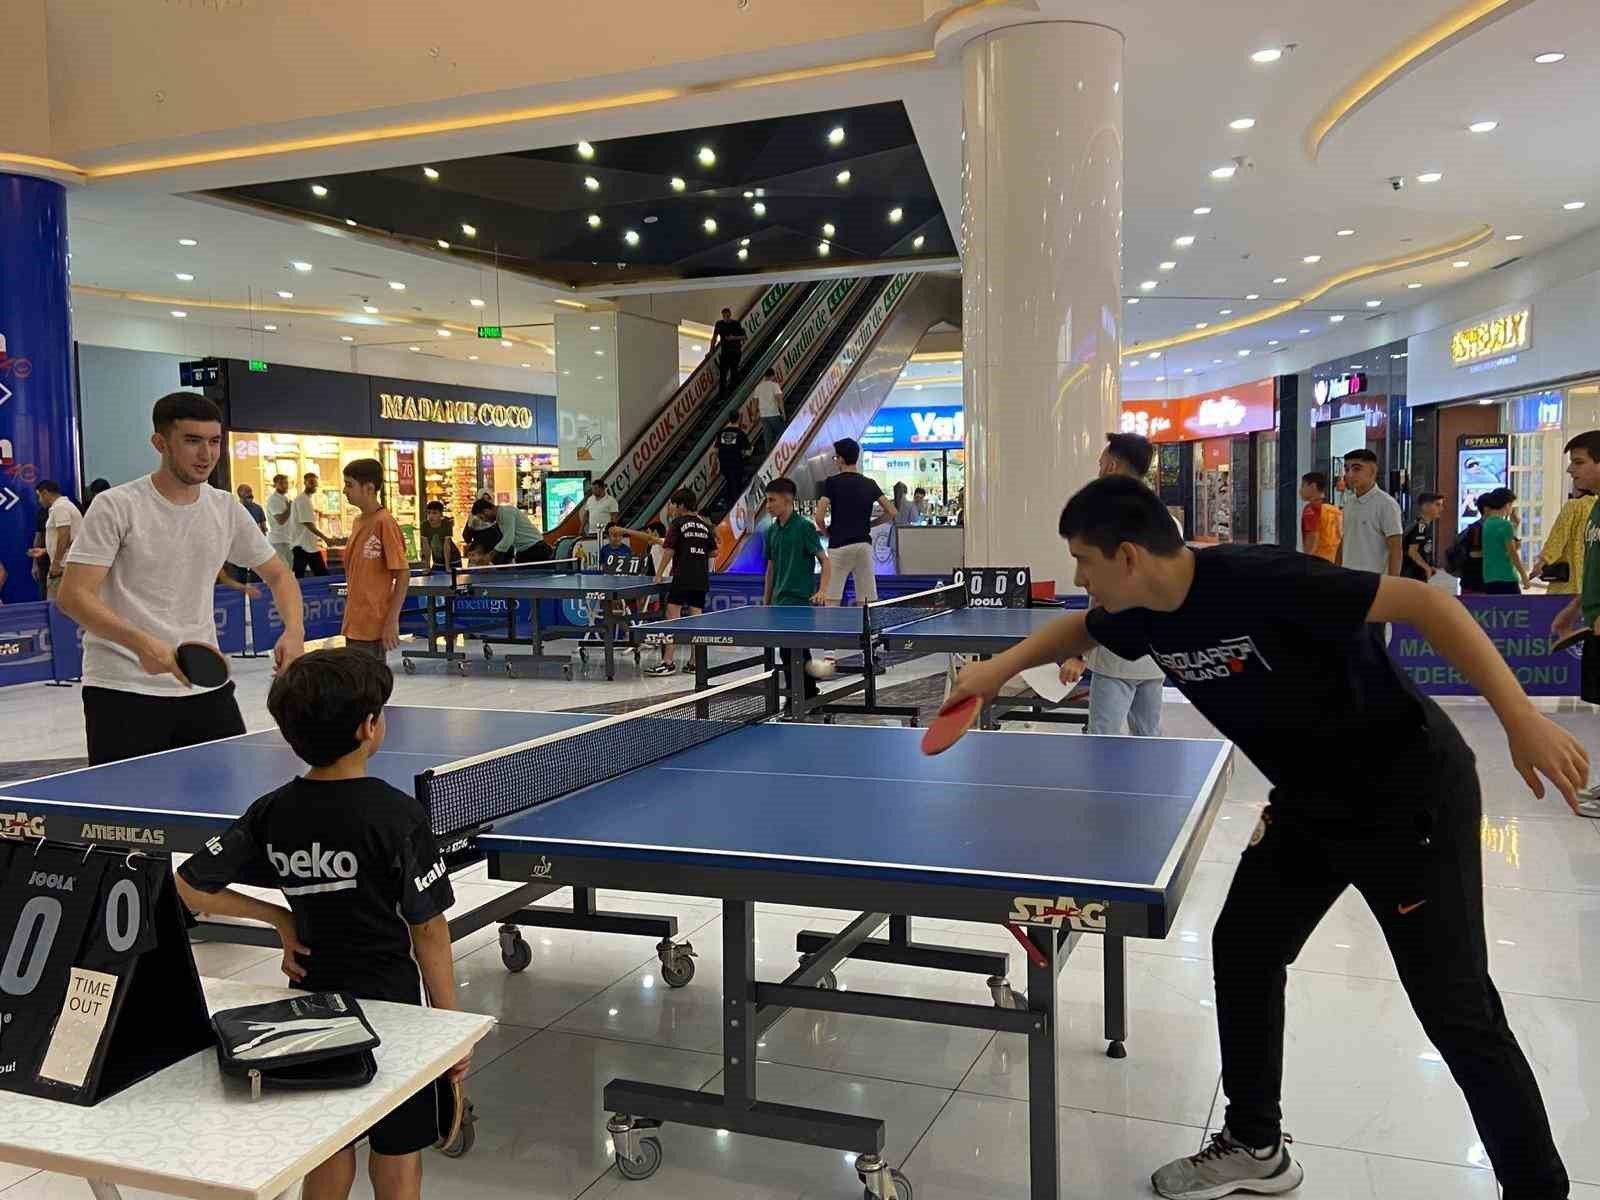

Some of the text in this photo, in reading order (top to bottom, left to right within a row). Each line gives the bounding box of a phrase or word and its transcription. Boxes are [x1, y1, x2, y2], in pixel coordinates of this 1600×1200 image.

[380, 393, 477, 424] MADAME
[477, 403, 533, 429] COCO
[616, 559, 625, 572] 2
[970, 575, 982, 595] 0
[995, 575, 1007, 595] 0
[1016, 571, 1026, 586] 0
[970, 598, 1003, 606] JOOLA
[1474, 607, 1529, 628] KİYE
[644, 633, 674, 644] STAG
[691, 635, 733, 645] AMERICAS
[0, 812, 46, 839] TAG
[81, 823, 166, 844] AMERICAS
[267, 842, 358, 878] beko
[28, 870, 75, 892] JOOLA
[105, 879, 141, 952] 0
[1008, 896, 1107, 934] STAG
[0, 896, 62, 996] 0
[75, 976, 111, 998] TIME
[69, 996, 102, 1015] OUT
